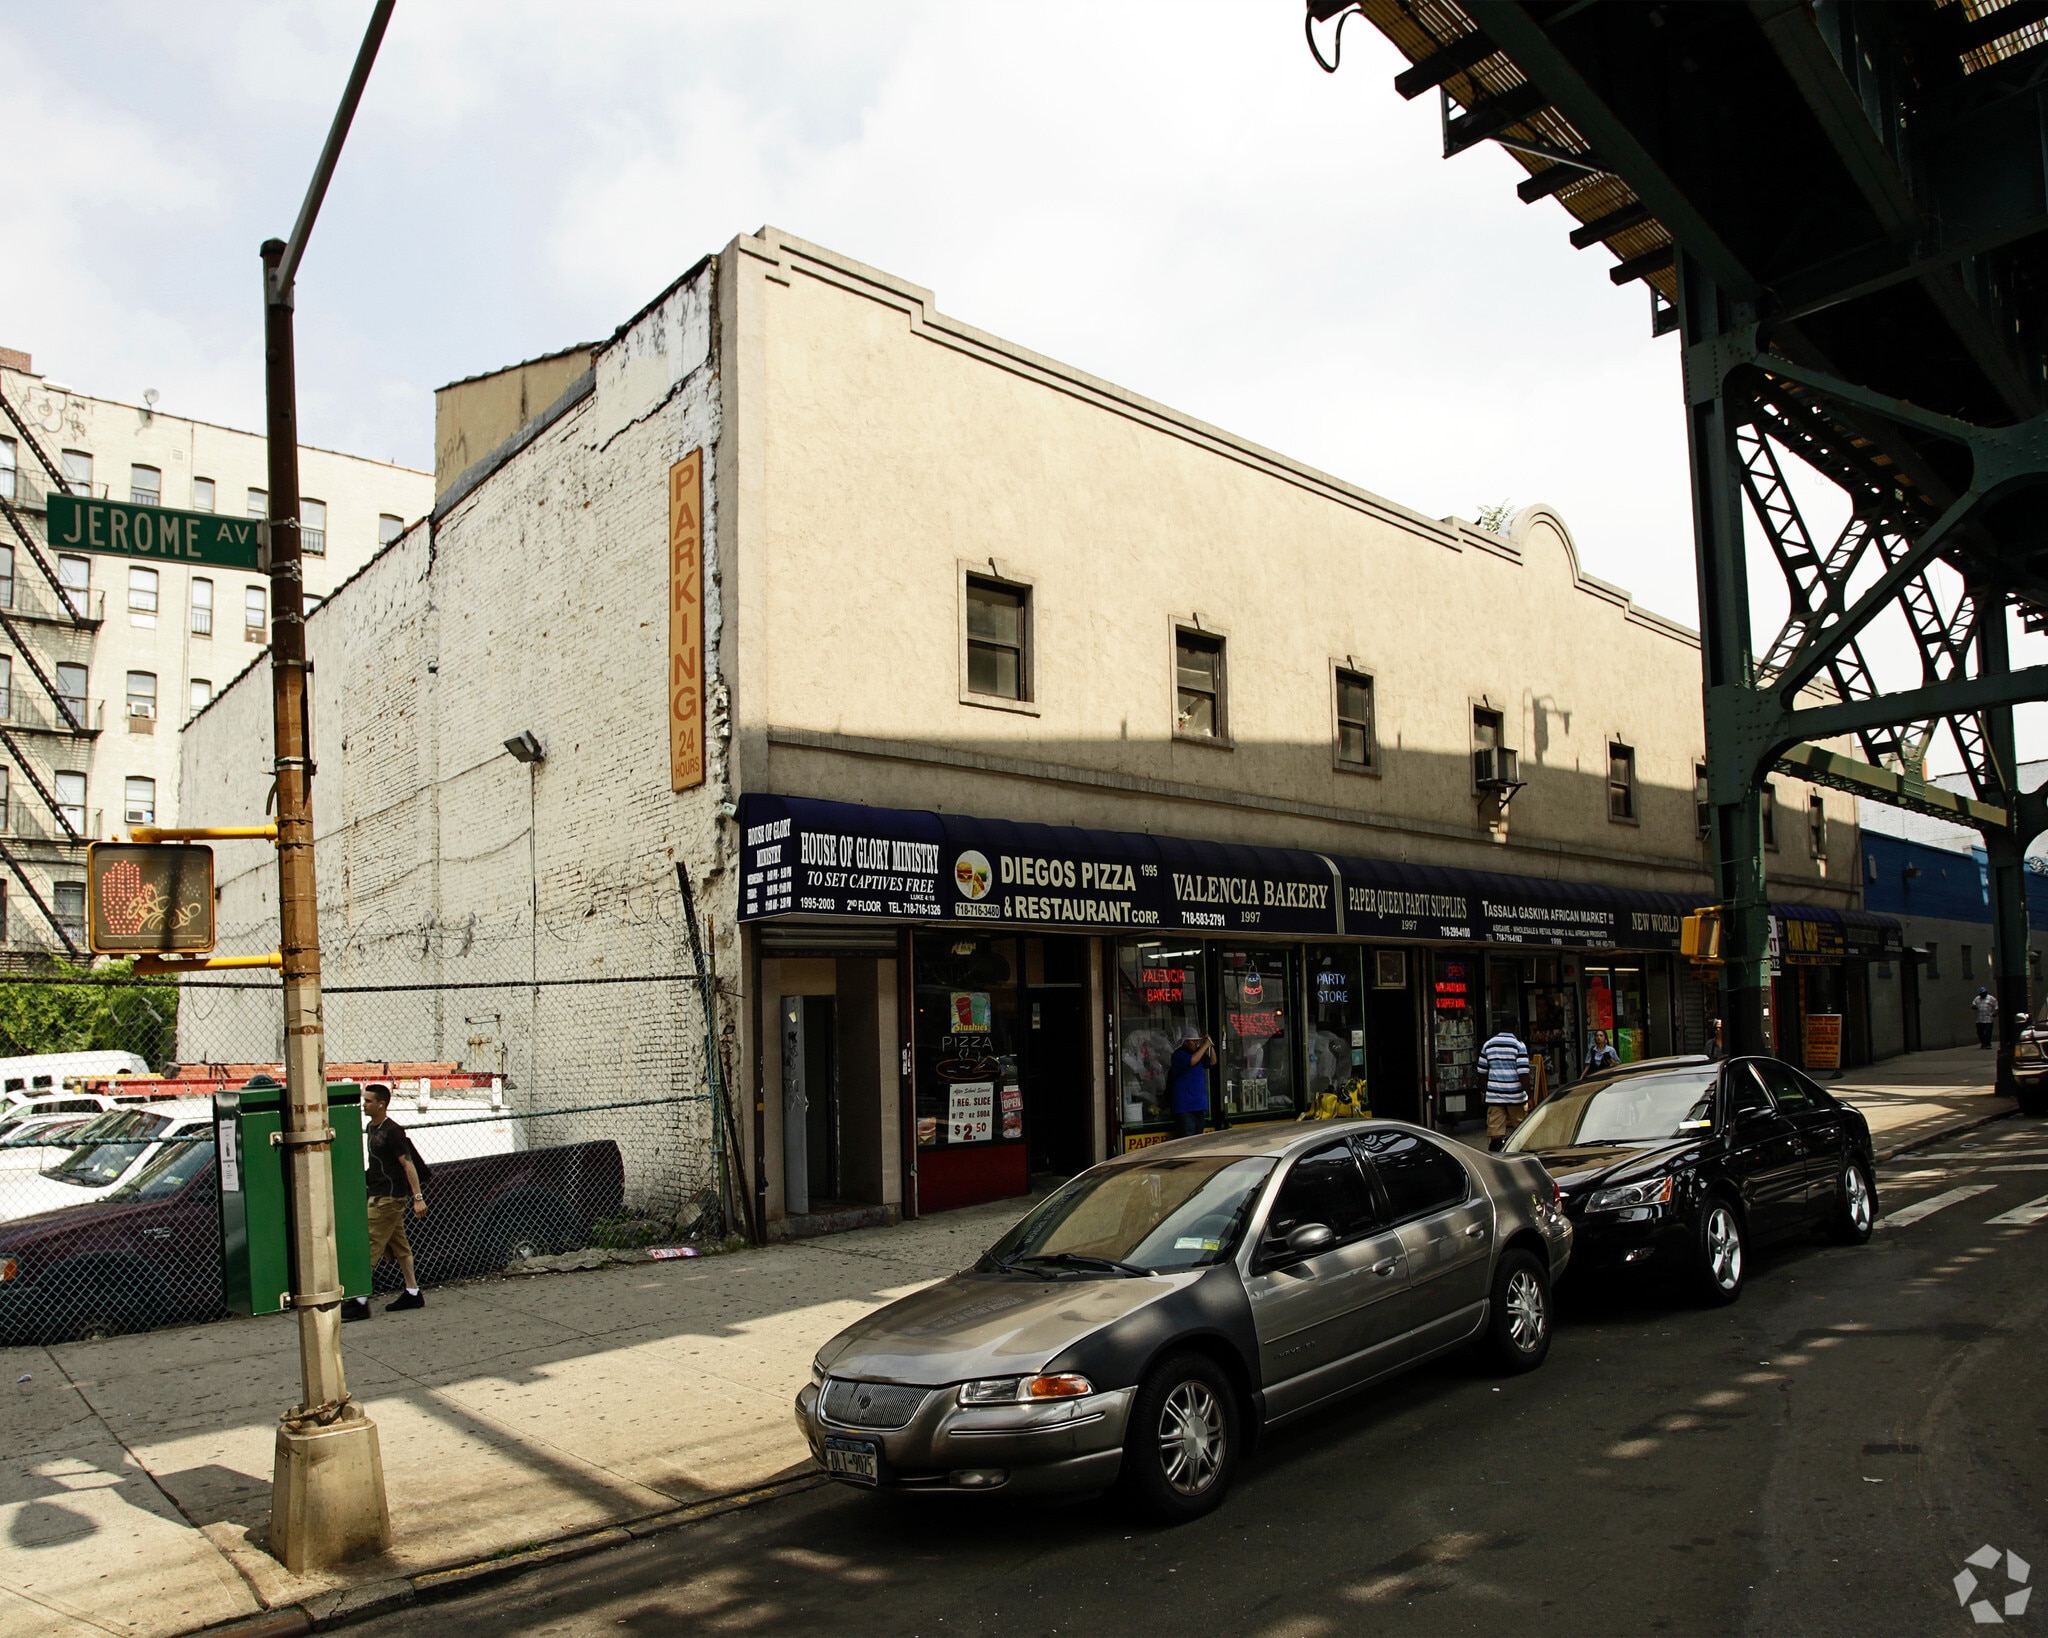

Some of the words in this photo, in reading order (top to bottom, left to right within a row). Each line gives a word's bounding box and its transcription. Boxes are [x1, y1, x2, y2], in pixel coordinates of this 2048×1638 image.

[63, 503, 202, 558] JEROME
[216, 522, 250, 545] AV
[674, 463, 697, 722] PARKING
[678, 730, 695, 759] 24
[675, 756, 700, 779] HOURS
[773, 818, 791, 840] GLORY
[801, 832, 837, 866] HOUSE
[839, 835, 853, 867] OF
[856, 837, 890, 870] GLORY
[892, 841, 939, 874] MINISTRY
[807, 870, 823, 886] TO
[824, 872, 848, 888] SET
[849, 874, 903, 892] CAPTIVES
[905, 878, 935, 893] FREE
[1000, 855, 1076, 889] DIEGOS
[1081, 861, 1137, 892] PIZZA
[1140, 864, 1158, 877] 1995
[1172, 873, 1260, 905] VALENCIA
[1263, 880, 1329, 909] BAKERY
[800, 897, 835, 910] 1995-2003
[858, 900, 882, 913] FLOOR
[903, 902, 941, 915] 718-716-1326
[1004, 895, 1013, 918] &
[1015, 895, 1132, 923] RESTAURANT
[1131, 909, 1160, 925] CORP.
[1349, 886, 1377, 912] PAPER
[1377, 889, 1404, 920] QUEEN
[1405, 892, 1430, 916] PARTY
[1431, 894, 1467, 919] SUPPLIES
[1482, 900, 1518, 919] TASSALA
[1518, 906, 1549, 920] GASKIYA
[1551, 908, 1580, 922] AFRICAN
[1580, 911, 1608, 924] MARKET
[1181, 911, 1225, 927] 718-583-2791
[1240, 911, 1261, 923] 1997
[1401, 920, 1418, 931] 1997
[1632, 912, 1650, 931] NEW
[1651, 914, 1680, 933] WORLD
[1141, 969, 1187, 982] VALENCIA
[1316, 973, 1346, 985] PARTY
[1147, 988, 1184, 1002] BAKERY
[1317, 990, 1348, 1002] STORE
[954, 1023, 988, 1032] Slushies
[941, 1036, 994, 1052] PIZZA
[974, 1096, 991, 1106] SLICE
[1003, 1097, 1021, 1109] OPEN
[977, 1110, 990, 1118] SODA
